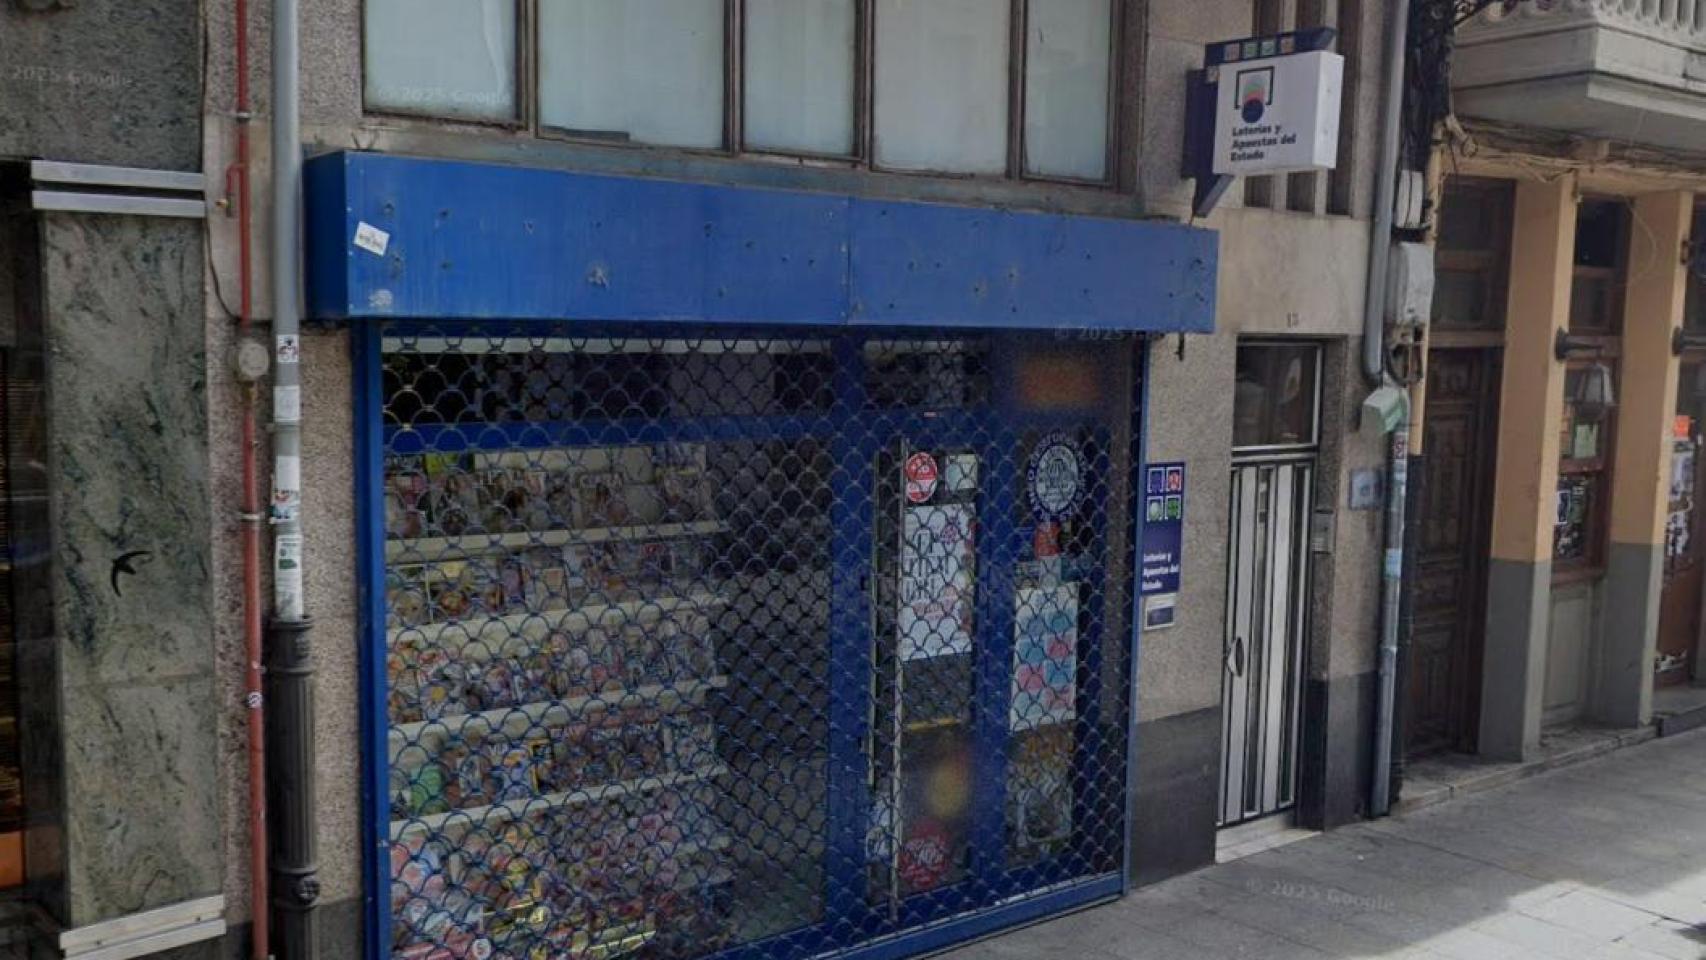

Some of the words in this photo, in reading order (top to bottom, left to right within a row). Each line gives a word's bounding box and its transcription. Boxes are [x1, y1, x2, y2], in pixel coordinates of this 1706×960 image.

[1232, 136, 1277, 150] Apuestas
[1281, 133, 1297, 144] del
[1230, 150, 1265, 162] Estado
